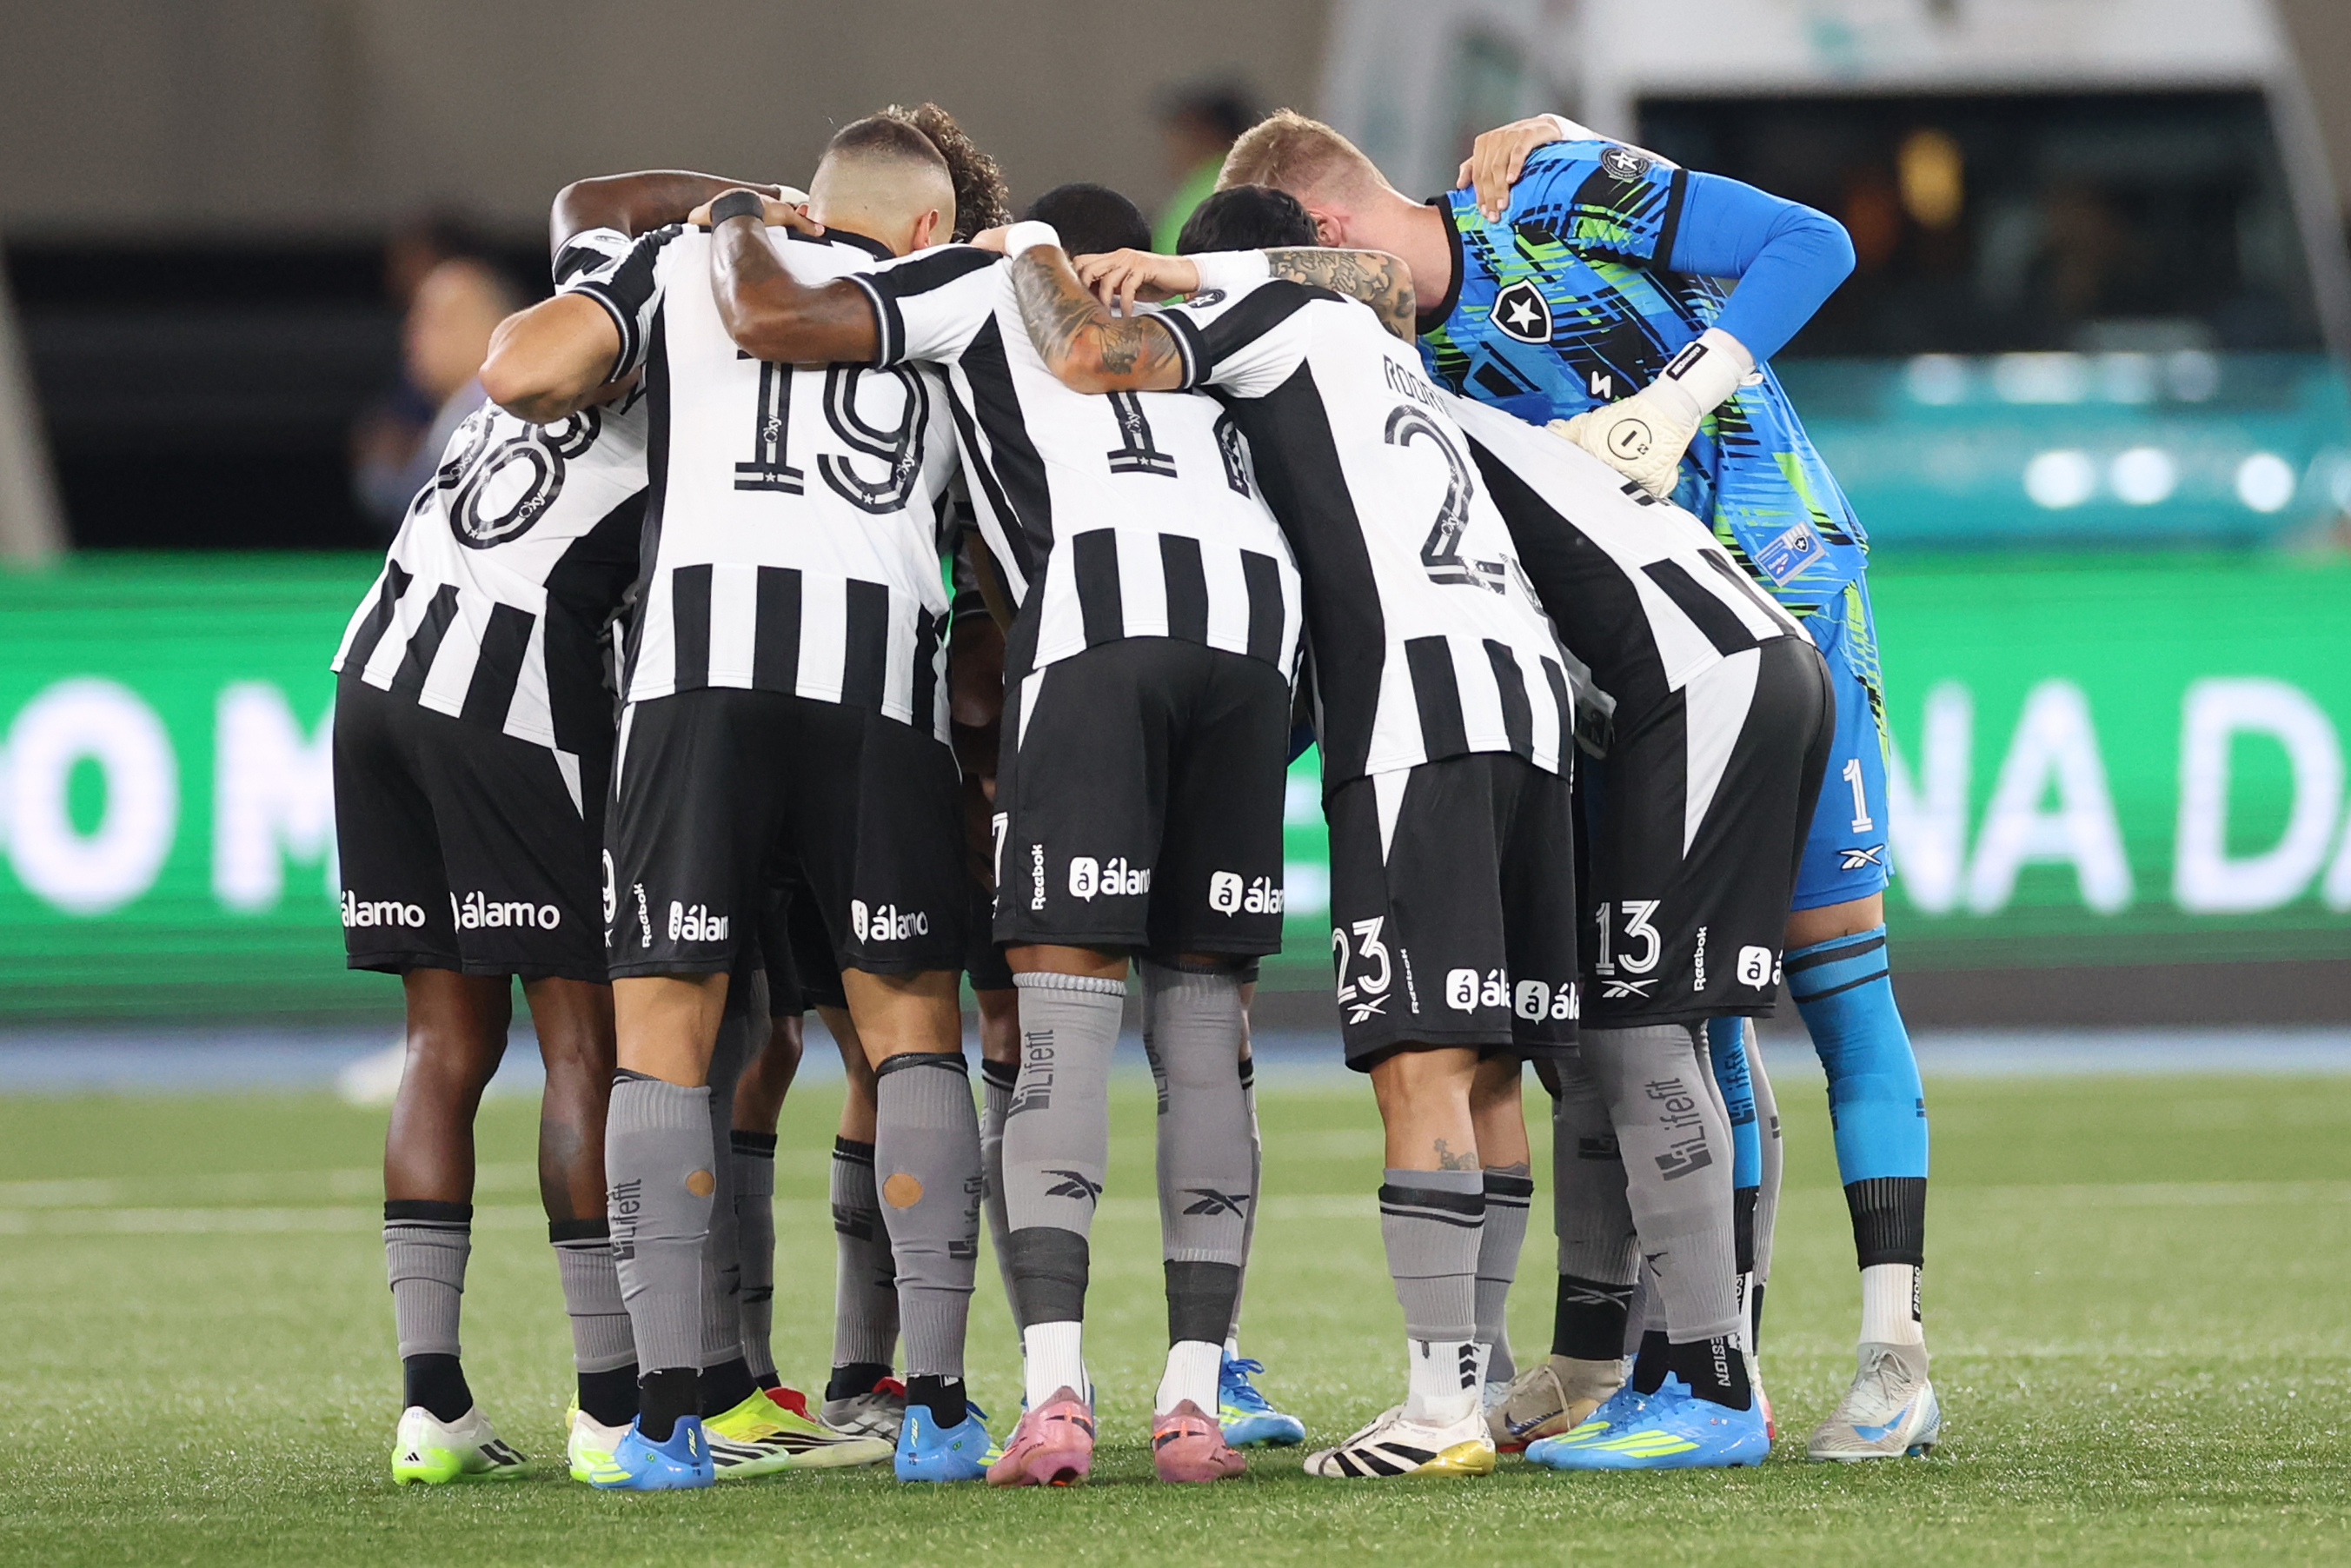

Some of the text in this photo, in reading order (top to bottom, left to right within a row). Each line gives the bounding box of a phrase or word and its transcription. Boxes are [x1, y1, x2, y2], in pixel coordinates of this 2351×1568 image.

[734, 349, 928, 515] 19
[1842, 759, 1872, 834] 1
[462, 891, 561, 930] álamo
[1032, 844, 1045, 911] Reebok
[634, 882, 652, 948] Reebok
[1595, 900, 1661, 975] 13
[1332, 915, 1391, 1006] 23
[1398, 948, 1421, 1015] Reebok
[1693, 926, 1708, 992] Reebok
